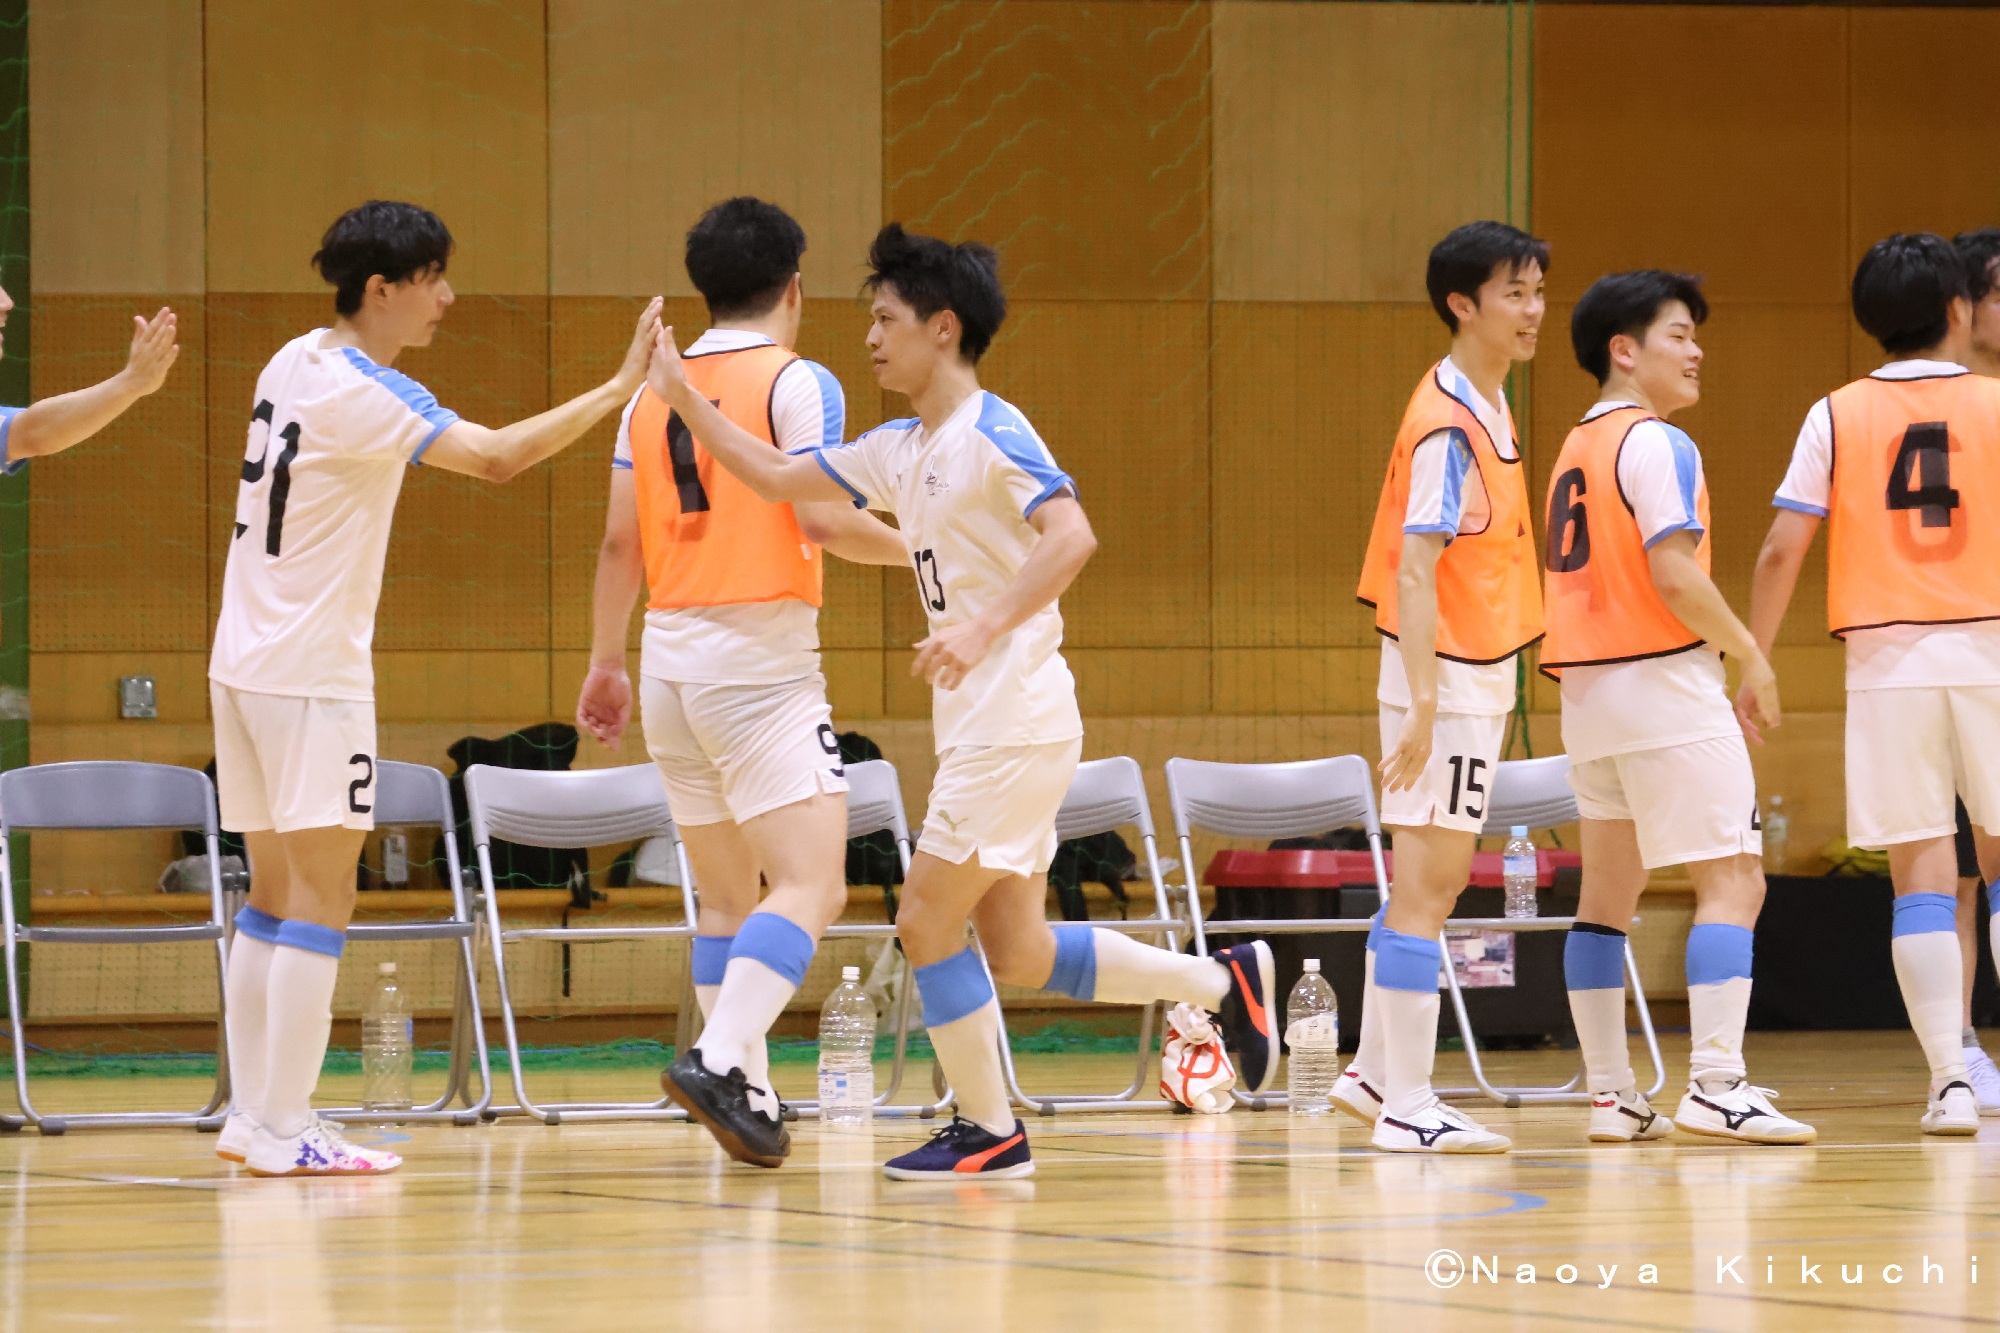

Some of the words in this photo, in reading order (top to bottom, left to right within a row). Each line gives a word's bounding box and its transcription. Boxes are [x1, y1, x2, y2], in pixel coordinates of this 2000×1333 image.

[1885, 421, 1959, 528] 4
[1545, 466, 1591, 573] 6
[914, 548, 946, 612] 13
[349, 753, 373, 814] 2
[1448, 755, 1487, 820] 15
